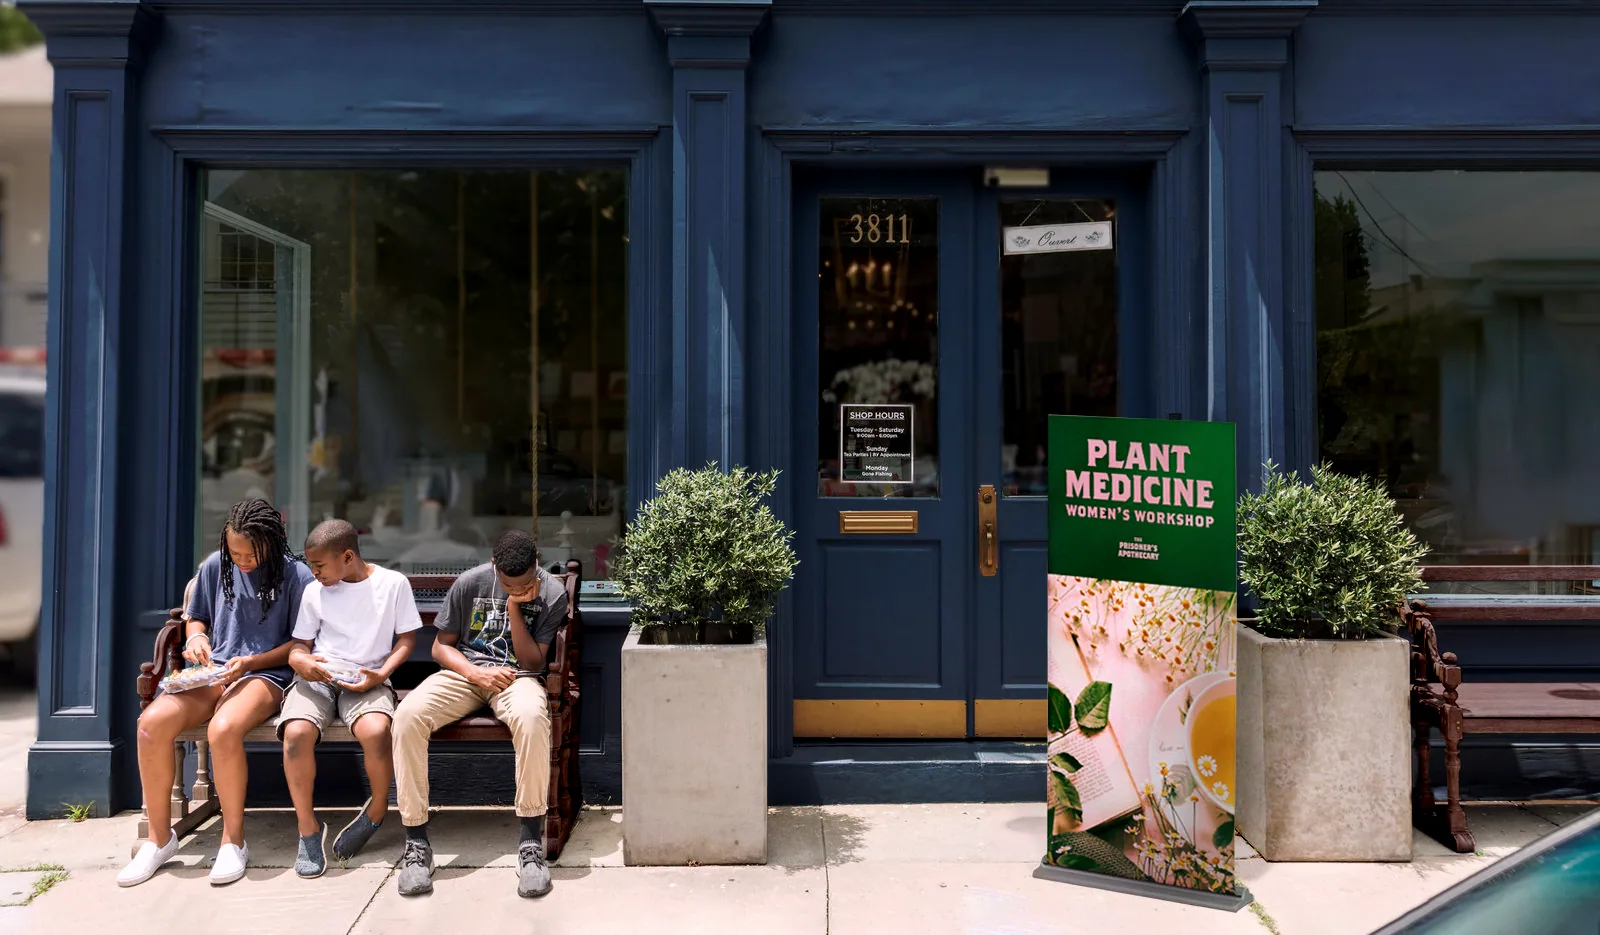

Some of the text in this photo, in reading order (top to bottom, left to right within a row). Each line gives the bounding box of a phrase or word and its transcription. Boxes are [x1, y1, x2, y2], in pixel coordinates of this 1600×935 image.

[850, 213, 910, 243] 3811
[1037, 230, 1078, 246] Ouvert
[875, 412, 904, 420] HOURS
[1087, 438, 1191, 473] PLANT
[1065, 469, 1215, 509] MEDICINE
[1065, 504, 1215, 528] WOMEN'S WORKSHOP
[1118, 550, 1159, 560] APOTHECARY
[1119, 542, 1158, 552] PRISONER'S
